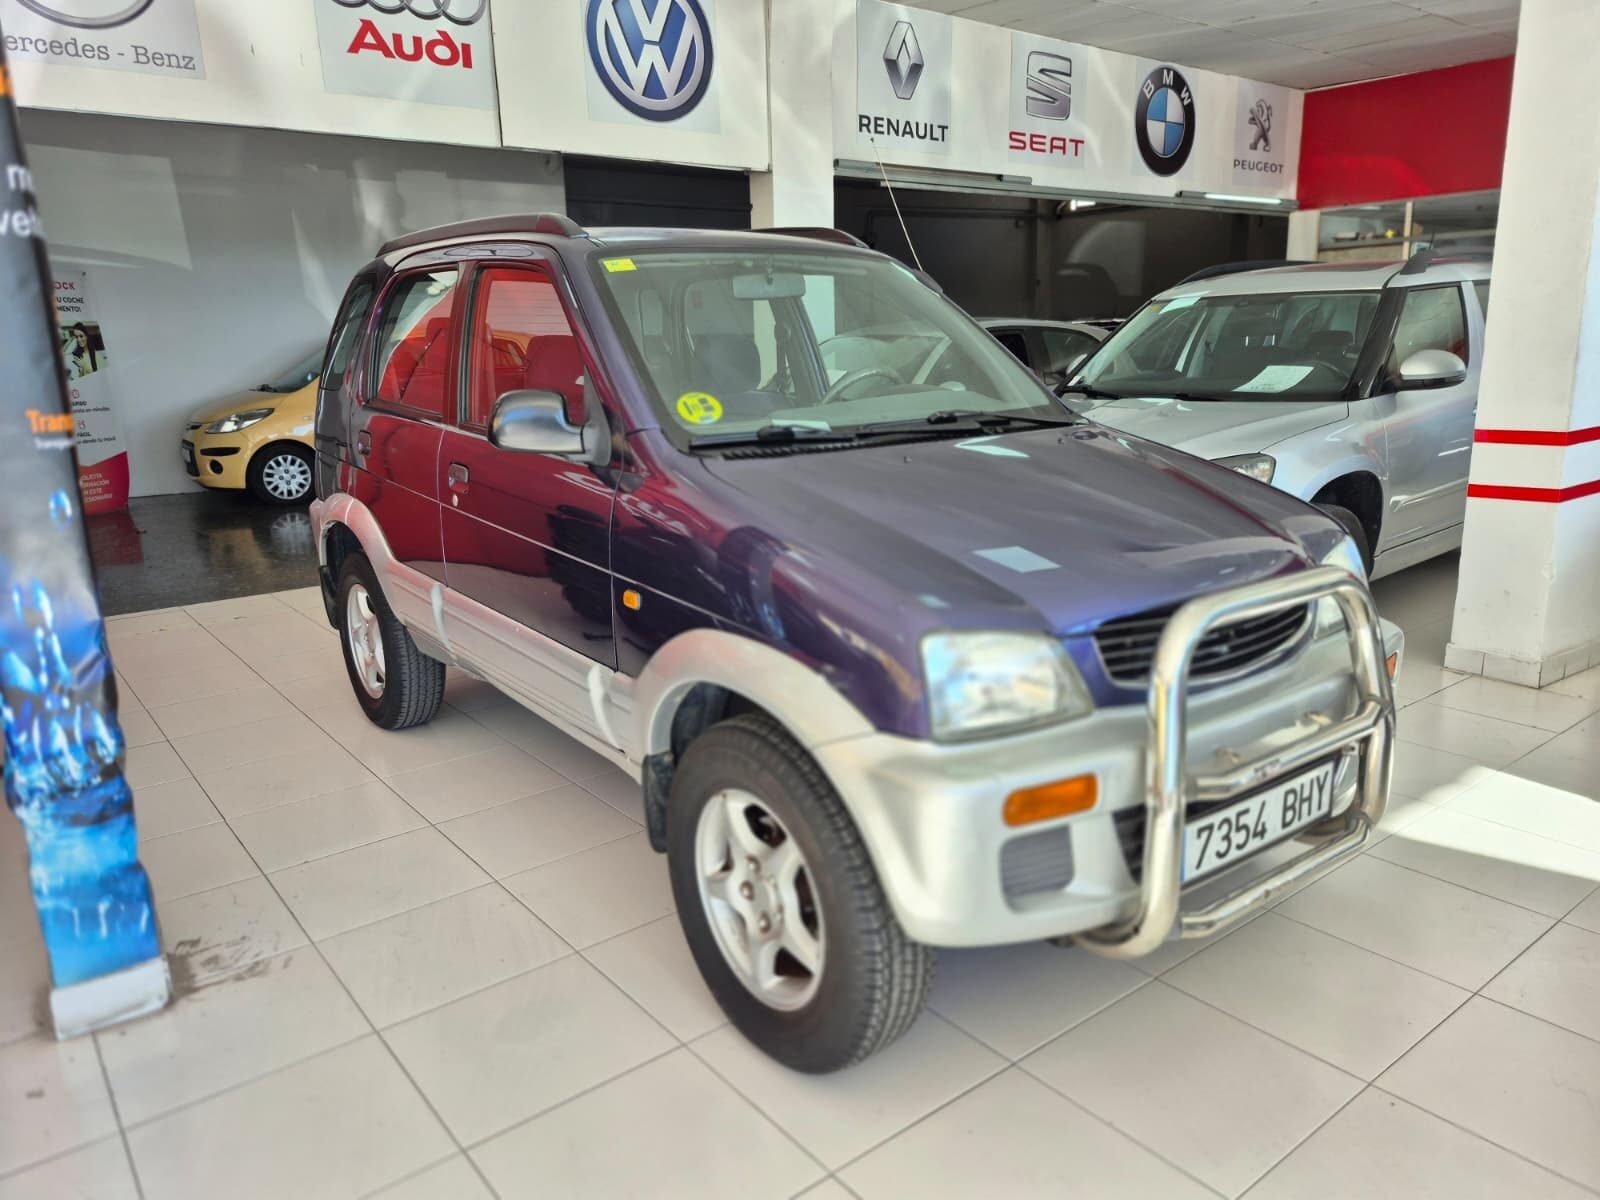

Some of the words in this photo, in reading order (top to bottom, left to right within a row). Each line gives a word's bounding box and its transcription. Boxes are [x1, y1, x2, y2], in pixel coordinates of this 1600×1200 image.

[4, 34, 110, 61] ercedes
[133, 45, 196, 71] Benz
[347, 18, 473, 69] Audi
[1142, 68, 1192, 106] BMW
[858, 114, 949, 142] RENAULT
[1008, 131, 1085, 157] SEAT
[1233, 159, 1285, 174] PEUGEOT
[55, 281, 76, 290] OCK
[1195, 799, 1268, 870] 7354
[1281, 770, 1330, 830] BHY
